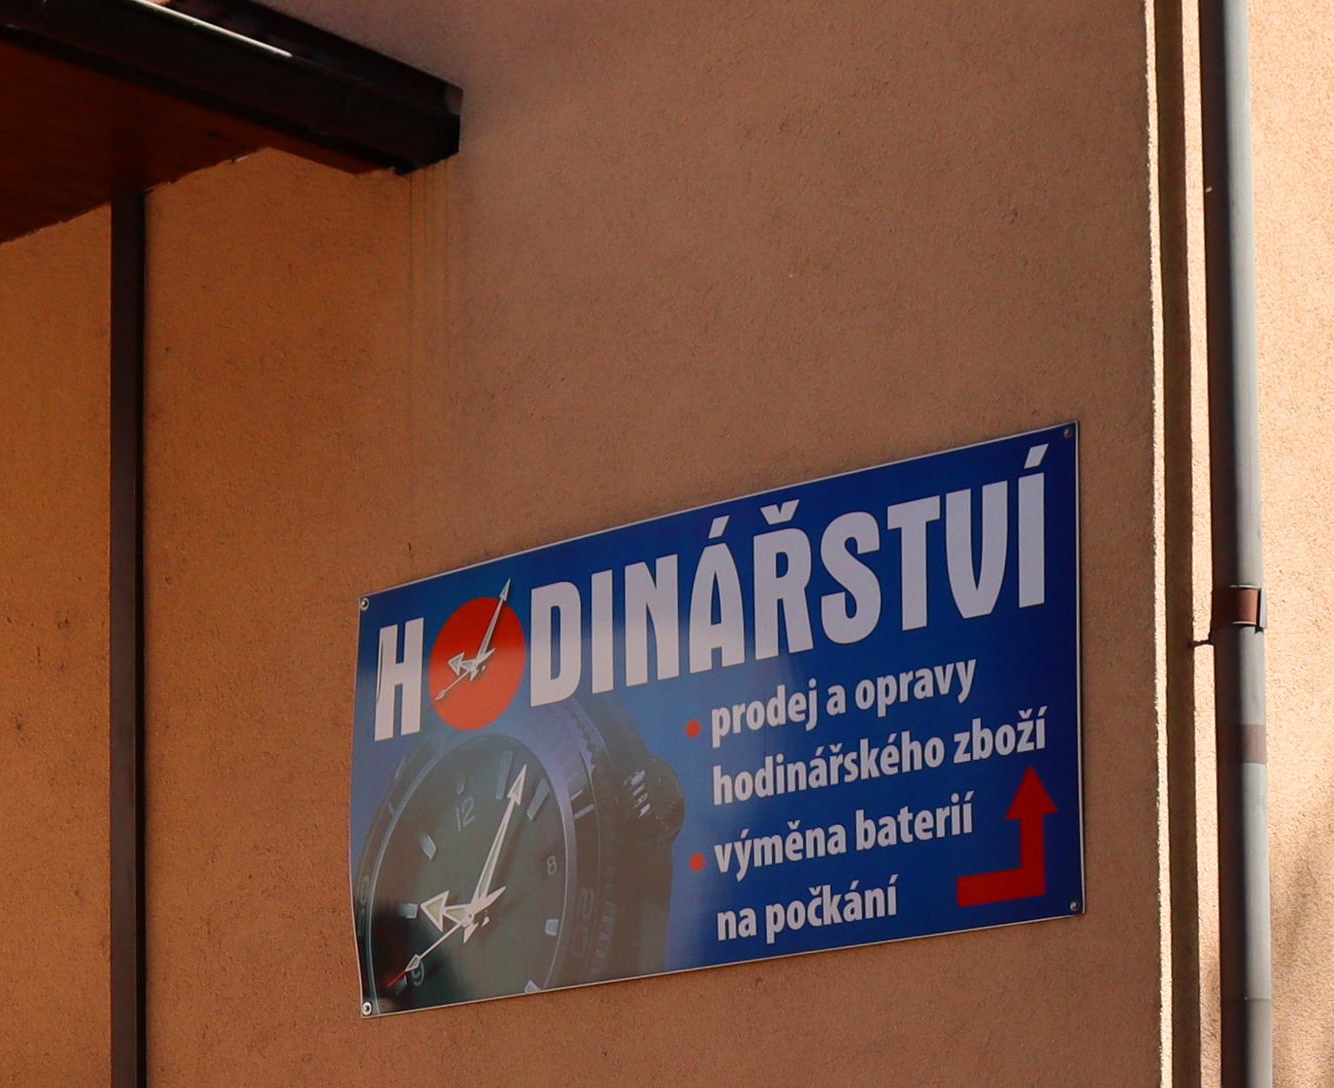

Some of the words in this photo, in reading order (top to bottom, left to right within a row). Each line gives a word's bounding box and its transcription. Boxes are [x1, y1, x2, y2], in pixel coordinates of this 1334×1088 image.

[711, 678, 818, 748] prodej
[826, 684, 846, 716] a
[855, 659, 977, 718] opravy
[713, 730, 945, 806] hodinářského
[953, 705, 1048, 764] zboží
[714, 819, 847, 882] výměna
[855, 790, 975, 851] baterií
[717, 906, 757, 941] na
[765, 873, 899, 944] počkání
